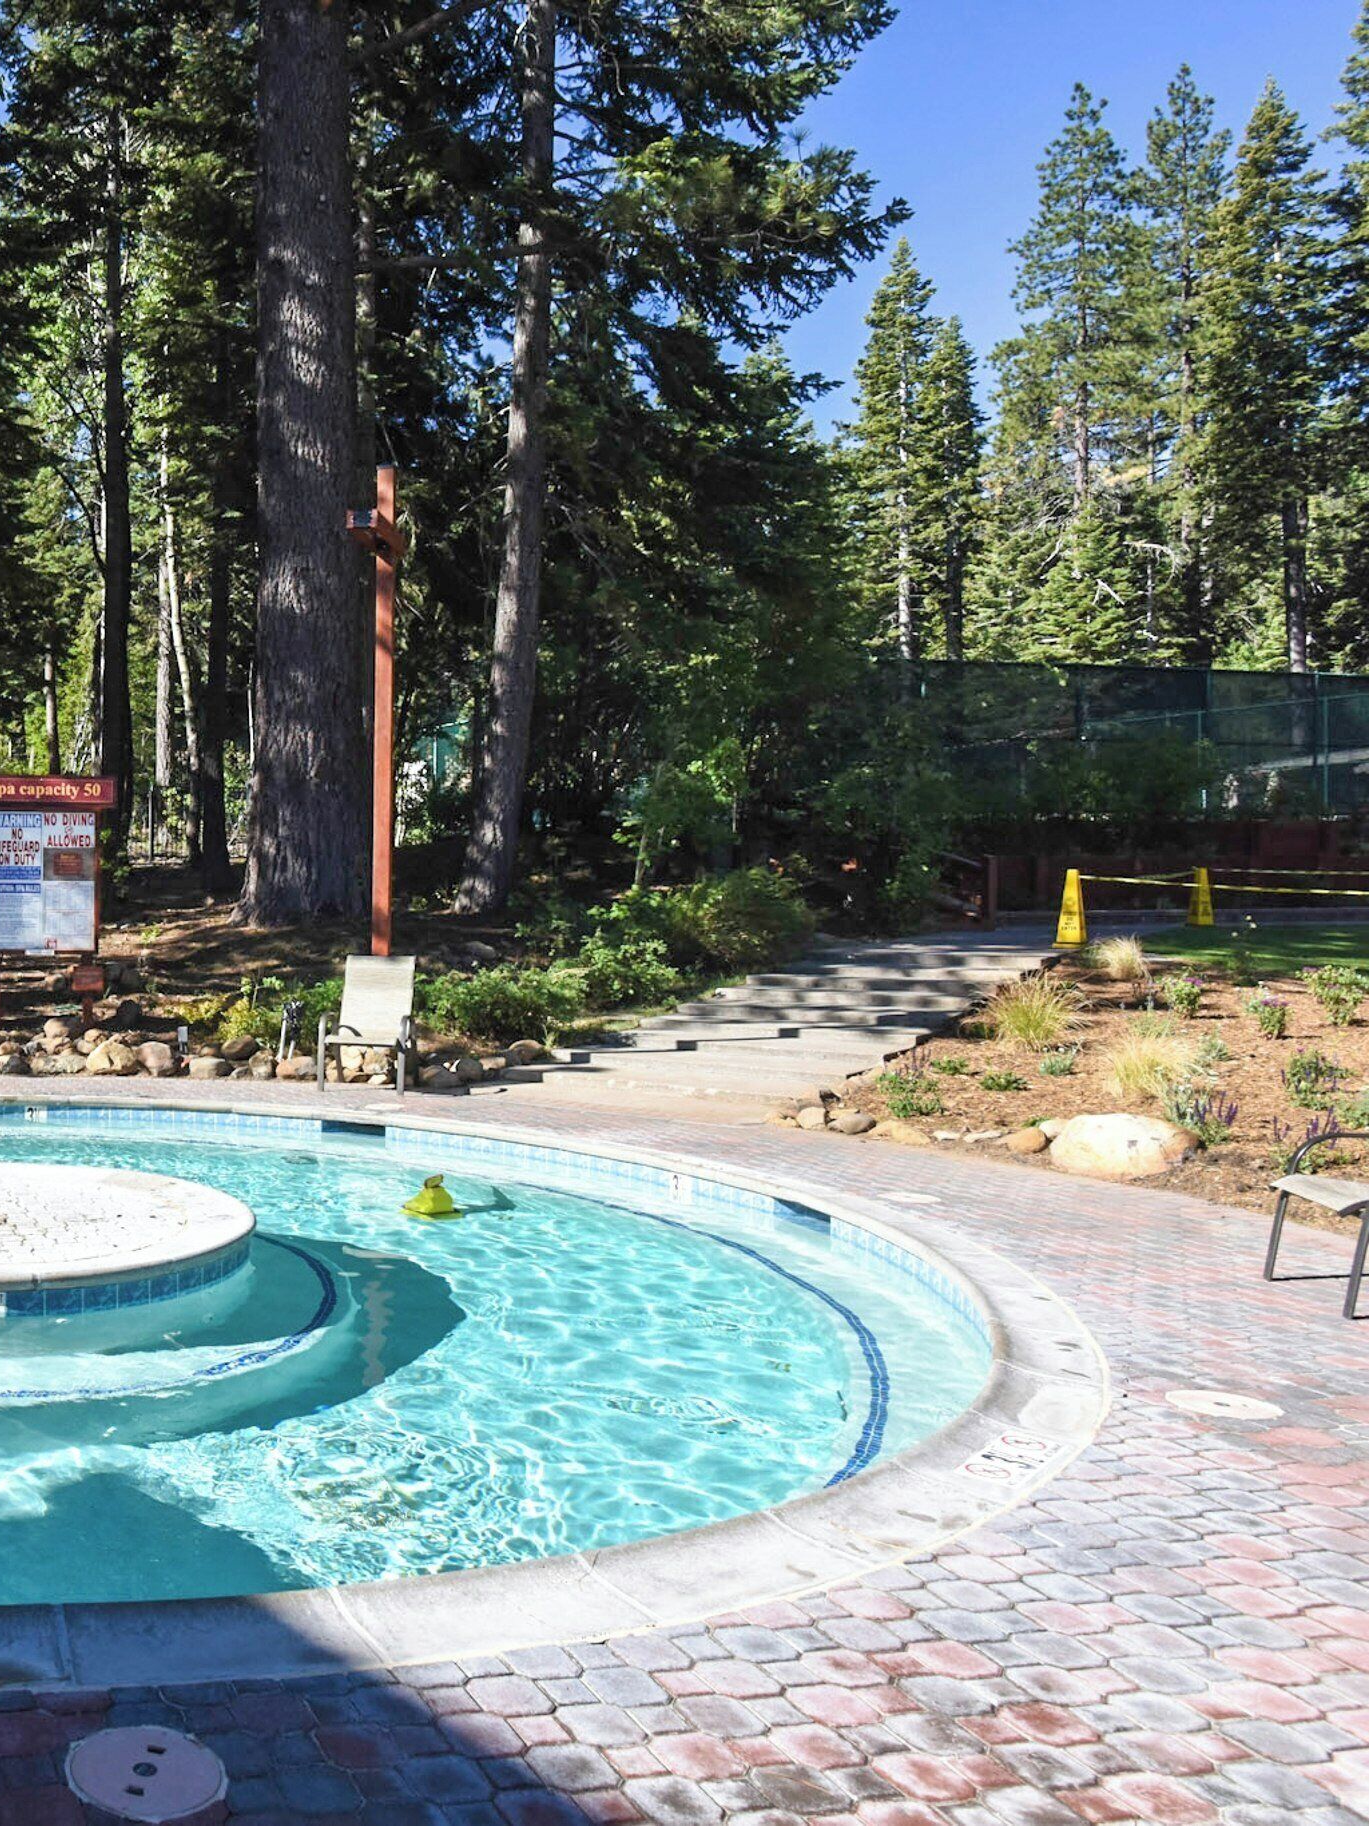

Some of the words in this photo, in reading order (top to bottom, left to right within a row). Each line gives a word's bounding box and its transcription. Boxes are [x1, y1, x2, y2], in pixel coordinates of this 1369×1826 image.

[19, 783, 80, 799] capacity
[83, 783, 102, 797] 50
[44, 814, 57, 826] NO
[62, 814, 94, 826] DIVING
[11, 828, 23, 839] NO
[47, 835, 91, 847] ALLOWED
[14, 853, 36, 865] DUTY
